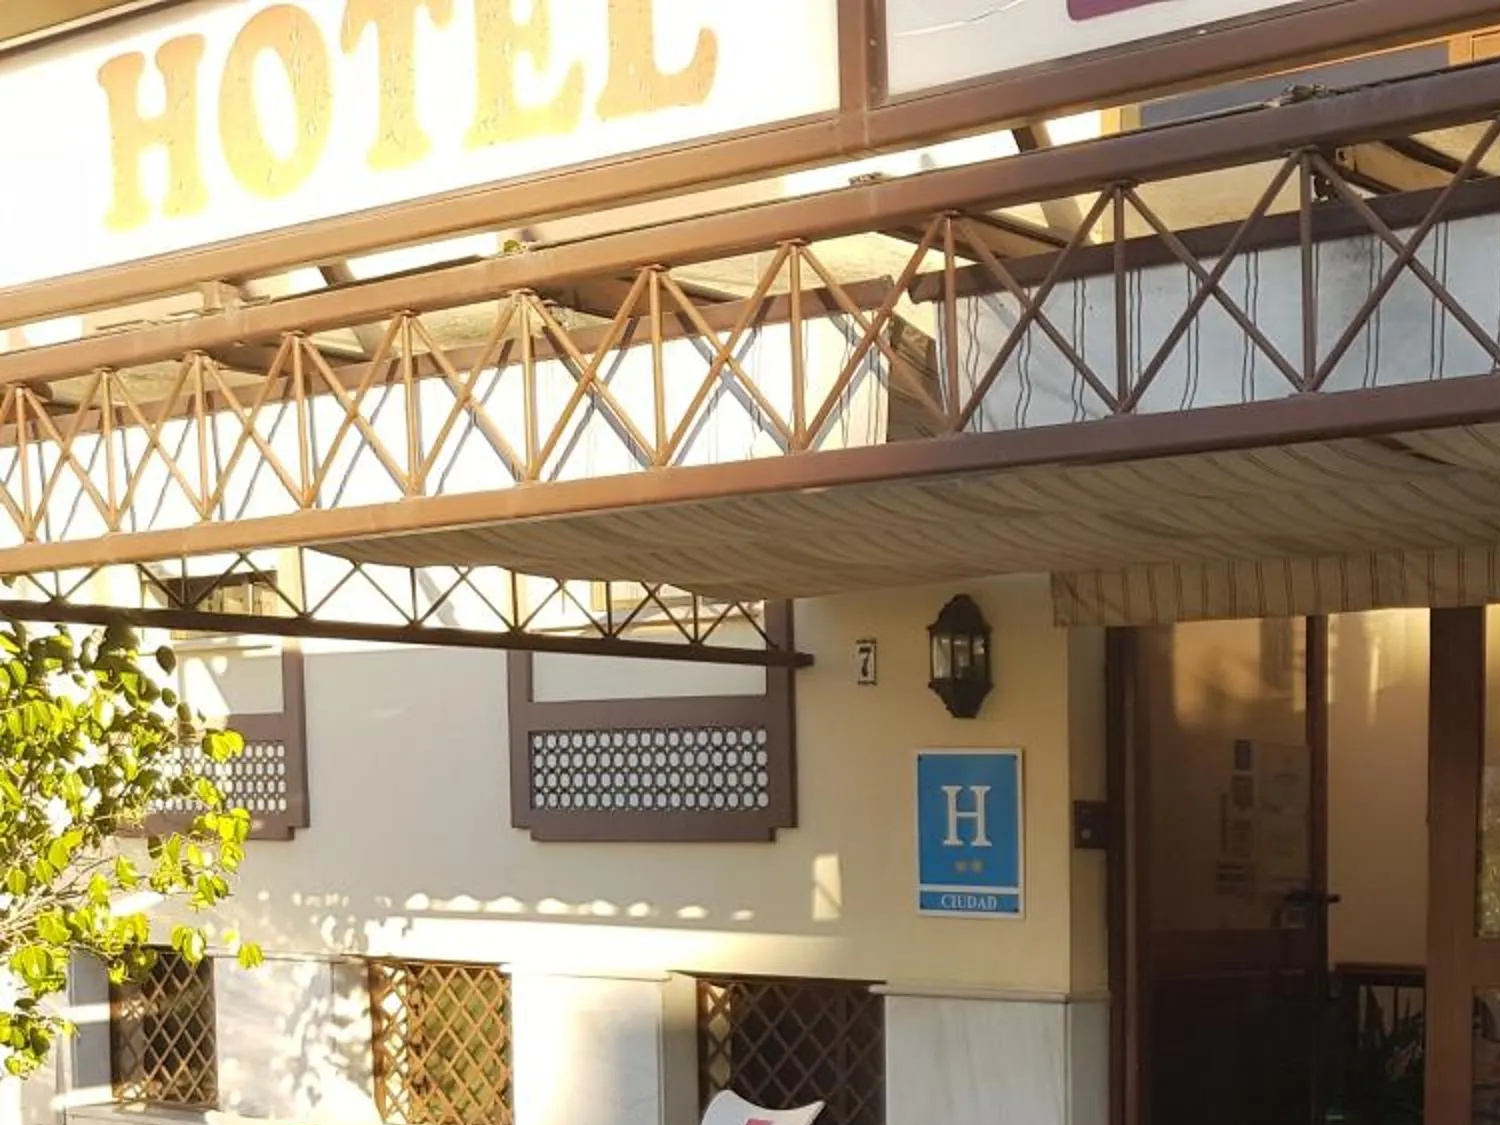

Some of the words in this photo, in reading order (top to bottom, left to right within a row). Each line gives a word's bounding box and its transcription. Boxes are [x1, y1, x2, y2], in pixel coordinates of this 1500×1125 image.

[97, 0, 718, 232] HOTEL
[859, 646, 872, 677] 7
[940, 785, 993, 847] H
[940, 893, 997, 910] CIUDAD
